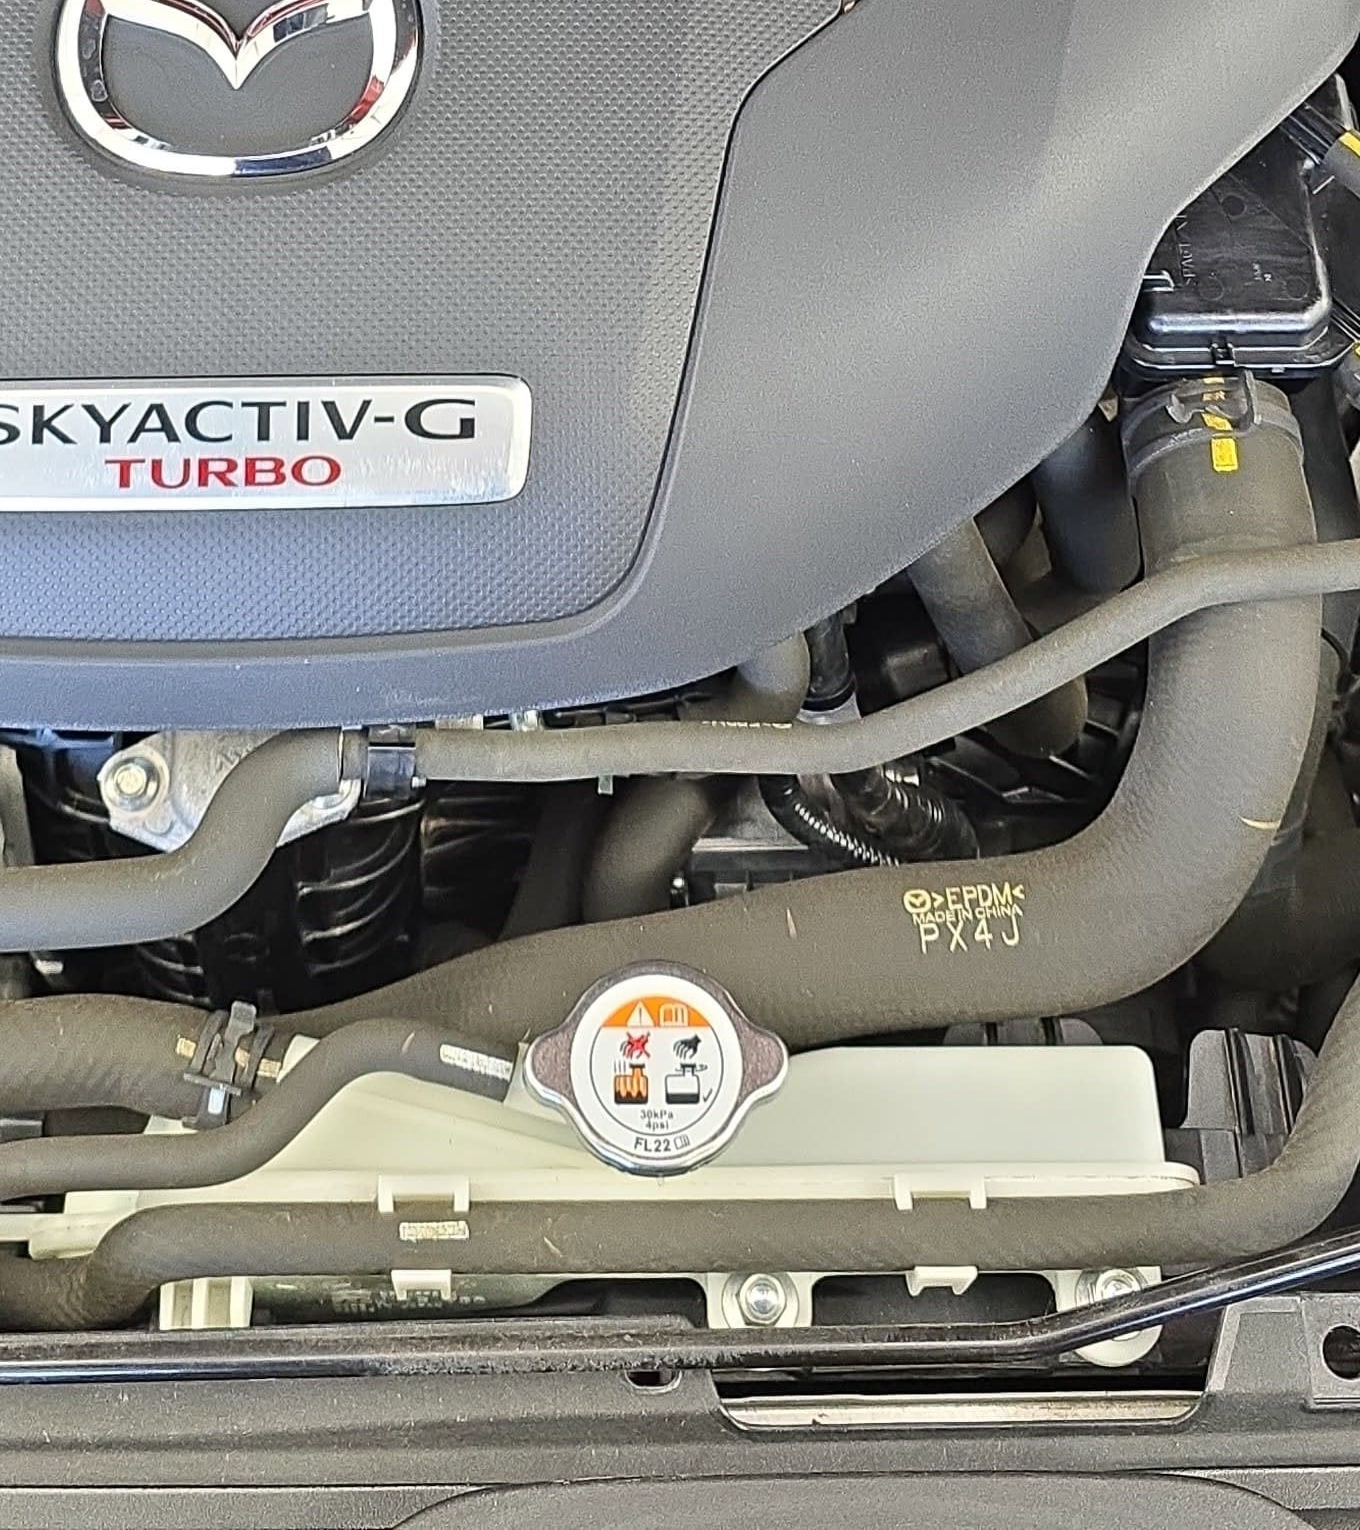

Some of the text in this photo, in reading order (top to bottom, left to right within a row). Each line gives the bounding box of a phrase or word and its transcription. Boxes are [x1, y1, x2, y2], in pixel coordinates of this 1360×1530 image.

[104, 454, 342, 490] TURBO
[931, 881, 1026, 911] >EPDM<
[912, 909, 955, 926] MADE
[974, 902, 1024, 920] CHINA
[640, 1110, 674, 1119] 30kPa
[645, 1121, 669, 1132] 4psi
[634, 1136, 671, 1152] FL22
